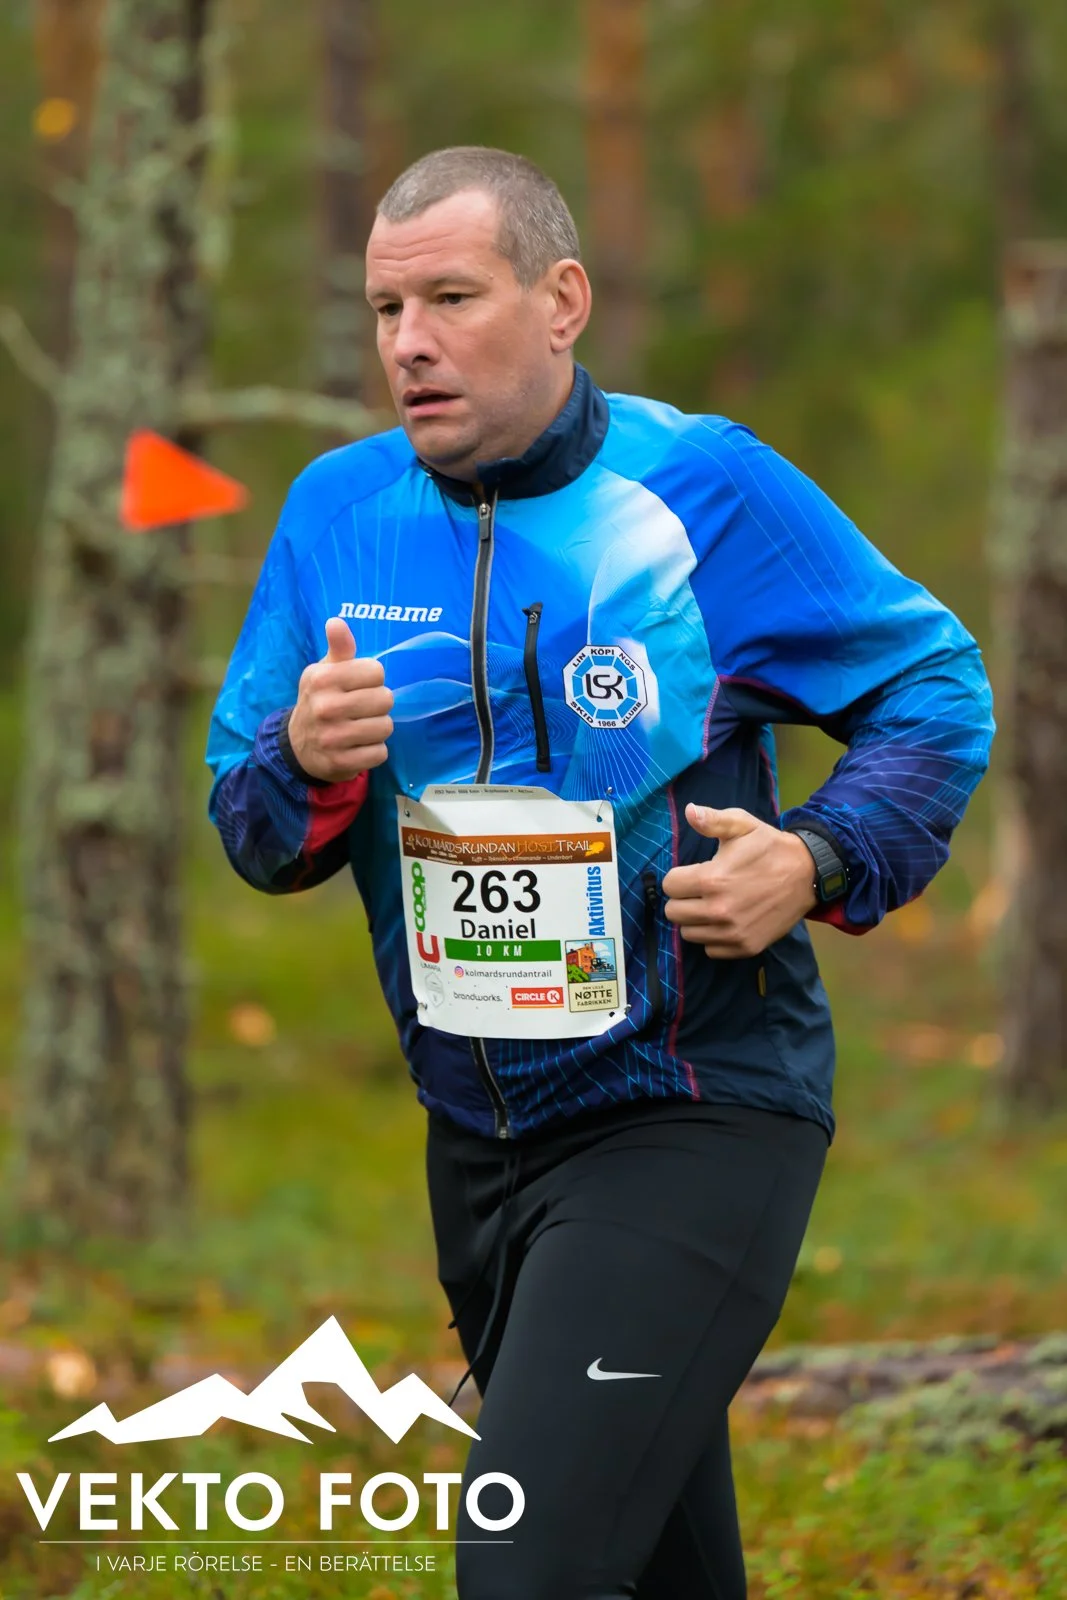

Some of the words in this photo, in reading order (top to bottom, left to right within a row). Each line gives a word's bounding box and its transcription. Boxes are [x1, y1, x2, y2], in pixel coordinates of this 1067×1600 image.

[338, 602, 443, 623] noname
[572, 652, 586, 668] LIN
[618, 653, 636, 671] NGS
[570, 701, 594, 724] SKID
[451, 869, 541, 913] 263
[585, 866, 605, 936] Aktivitus
[460, 918, 536, 939] Daniel
[476, 945, 492, 956] 10
[503, 945, 522, 956] KM
[465, 969, 552, 978] kolmardsrundantrail
[514, 992, 546, 1001] CIRCLE
[575, 989, 612, 1001] NØTTE
